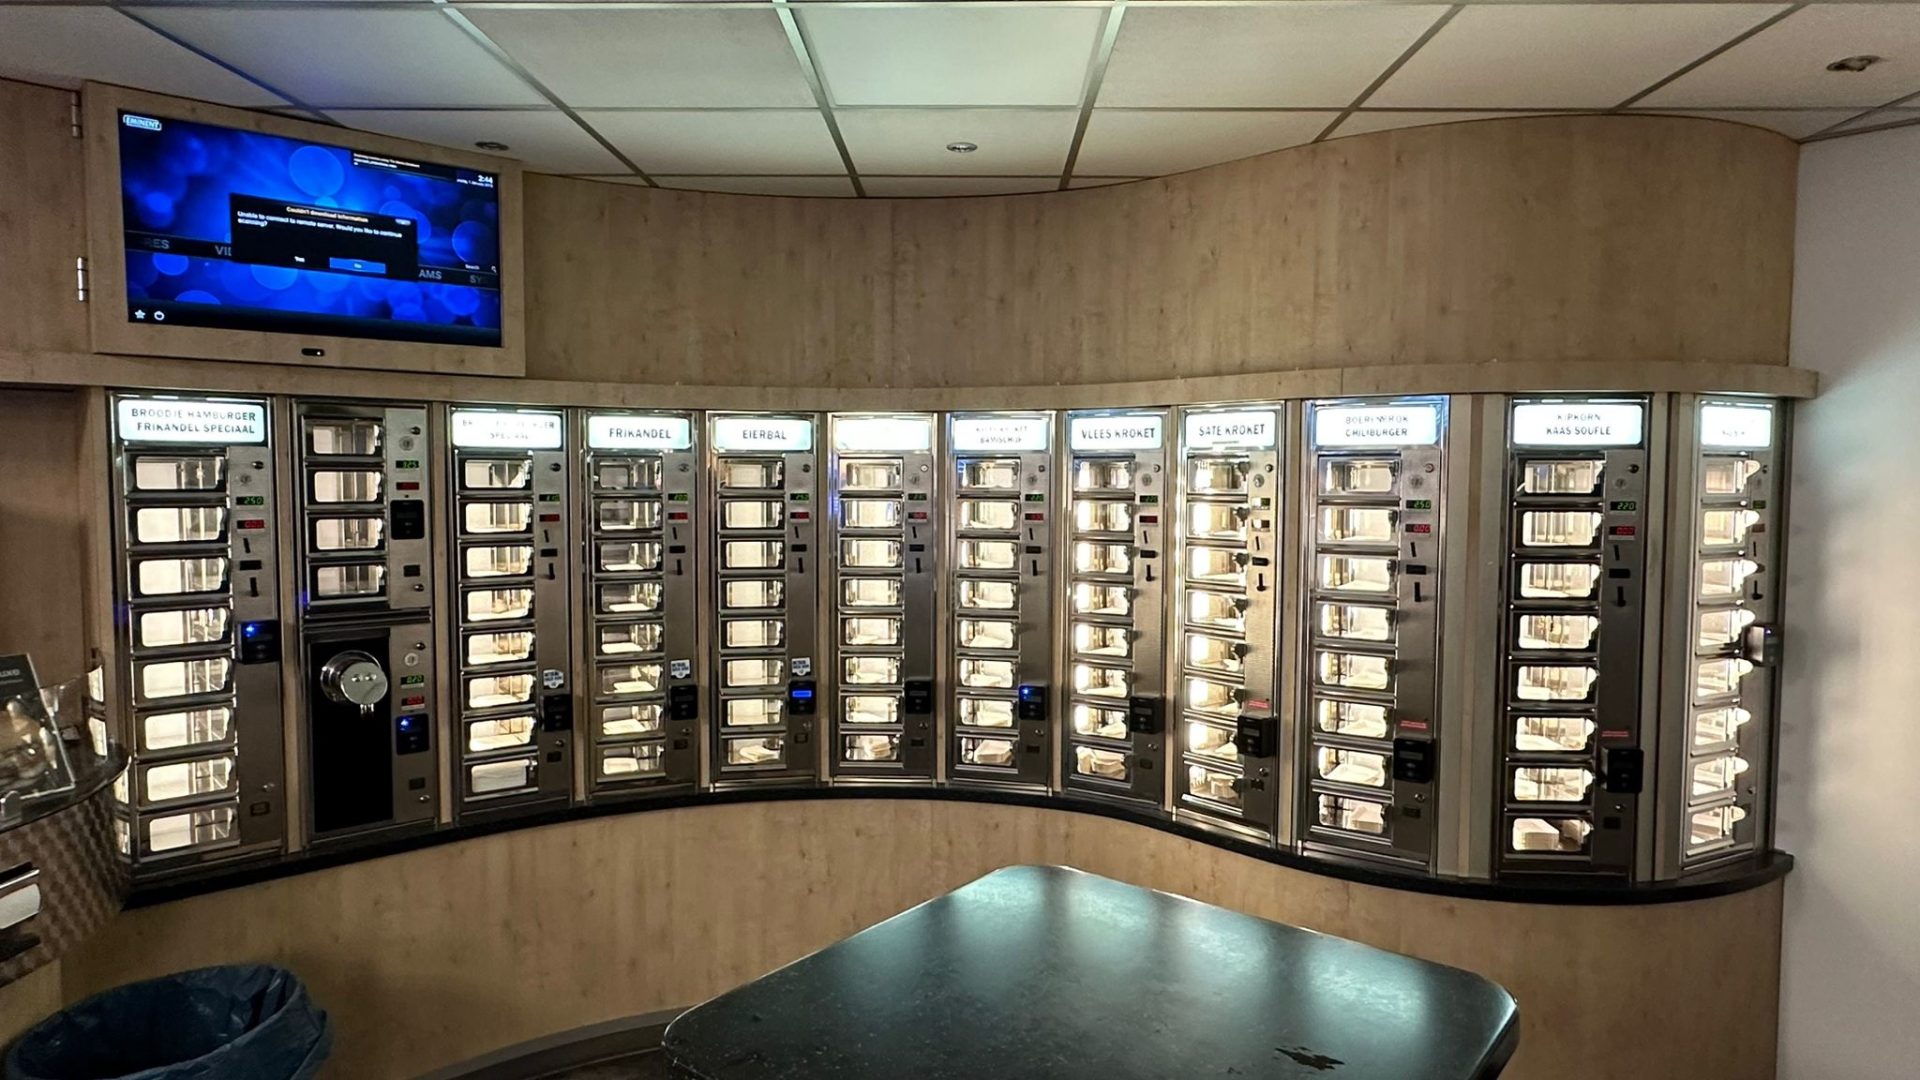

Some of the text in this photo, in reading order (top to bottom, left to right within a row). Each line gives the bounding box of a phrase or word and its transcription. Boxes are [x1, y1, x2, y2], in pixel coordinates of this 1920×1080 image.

[187, 410, 256, 421] HAMBURGER
[137, 422, 255, 434] FRIKANDEL SPECIAAL
[609, 427, 672, 439] FRIKANDEL
[1081, 427, 1156, 439] VLEES KROKET
[1198, 423, 1265, 437] SATE KROKET
[1345, 427, 1409, 437] CHILIBURGER
[1546, 426, 1572, 435] KAAS
[742, 429, 787, 440] EIERBAL
